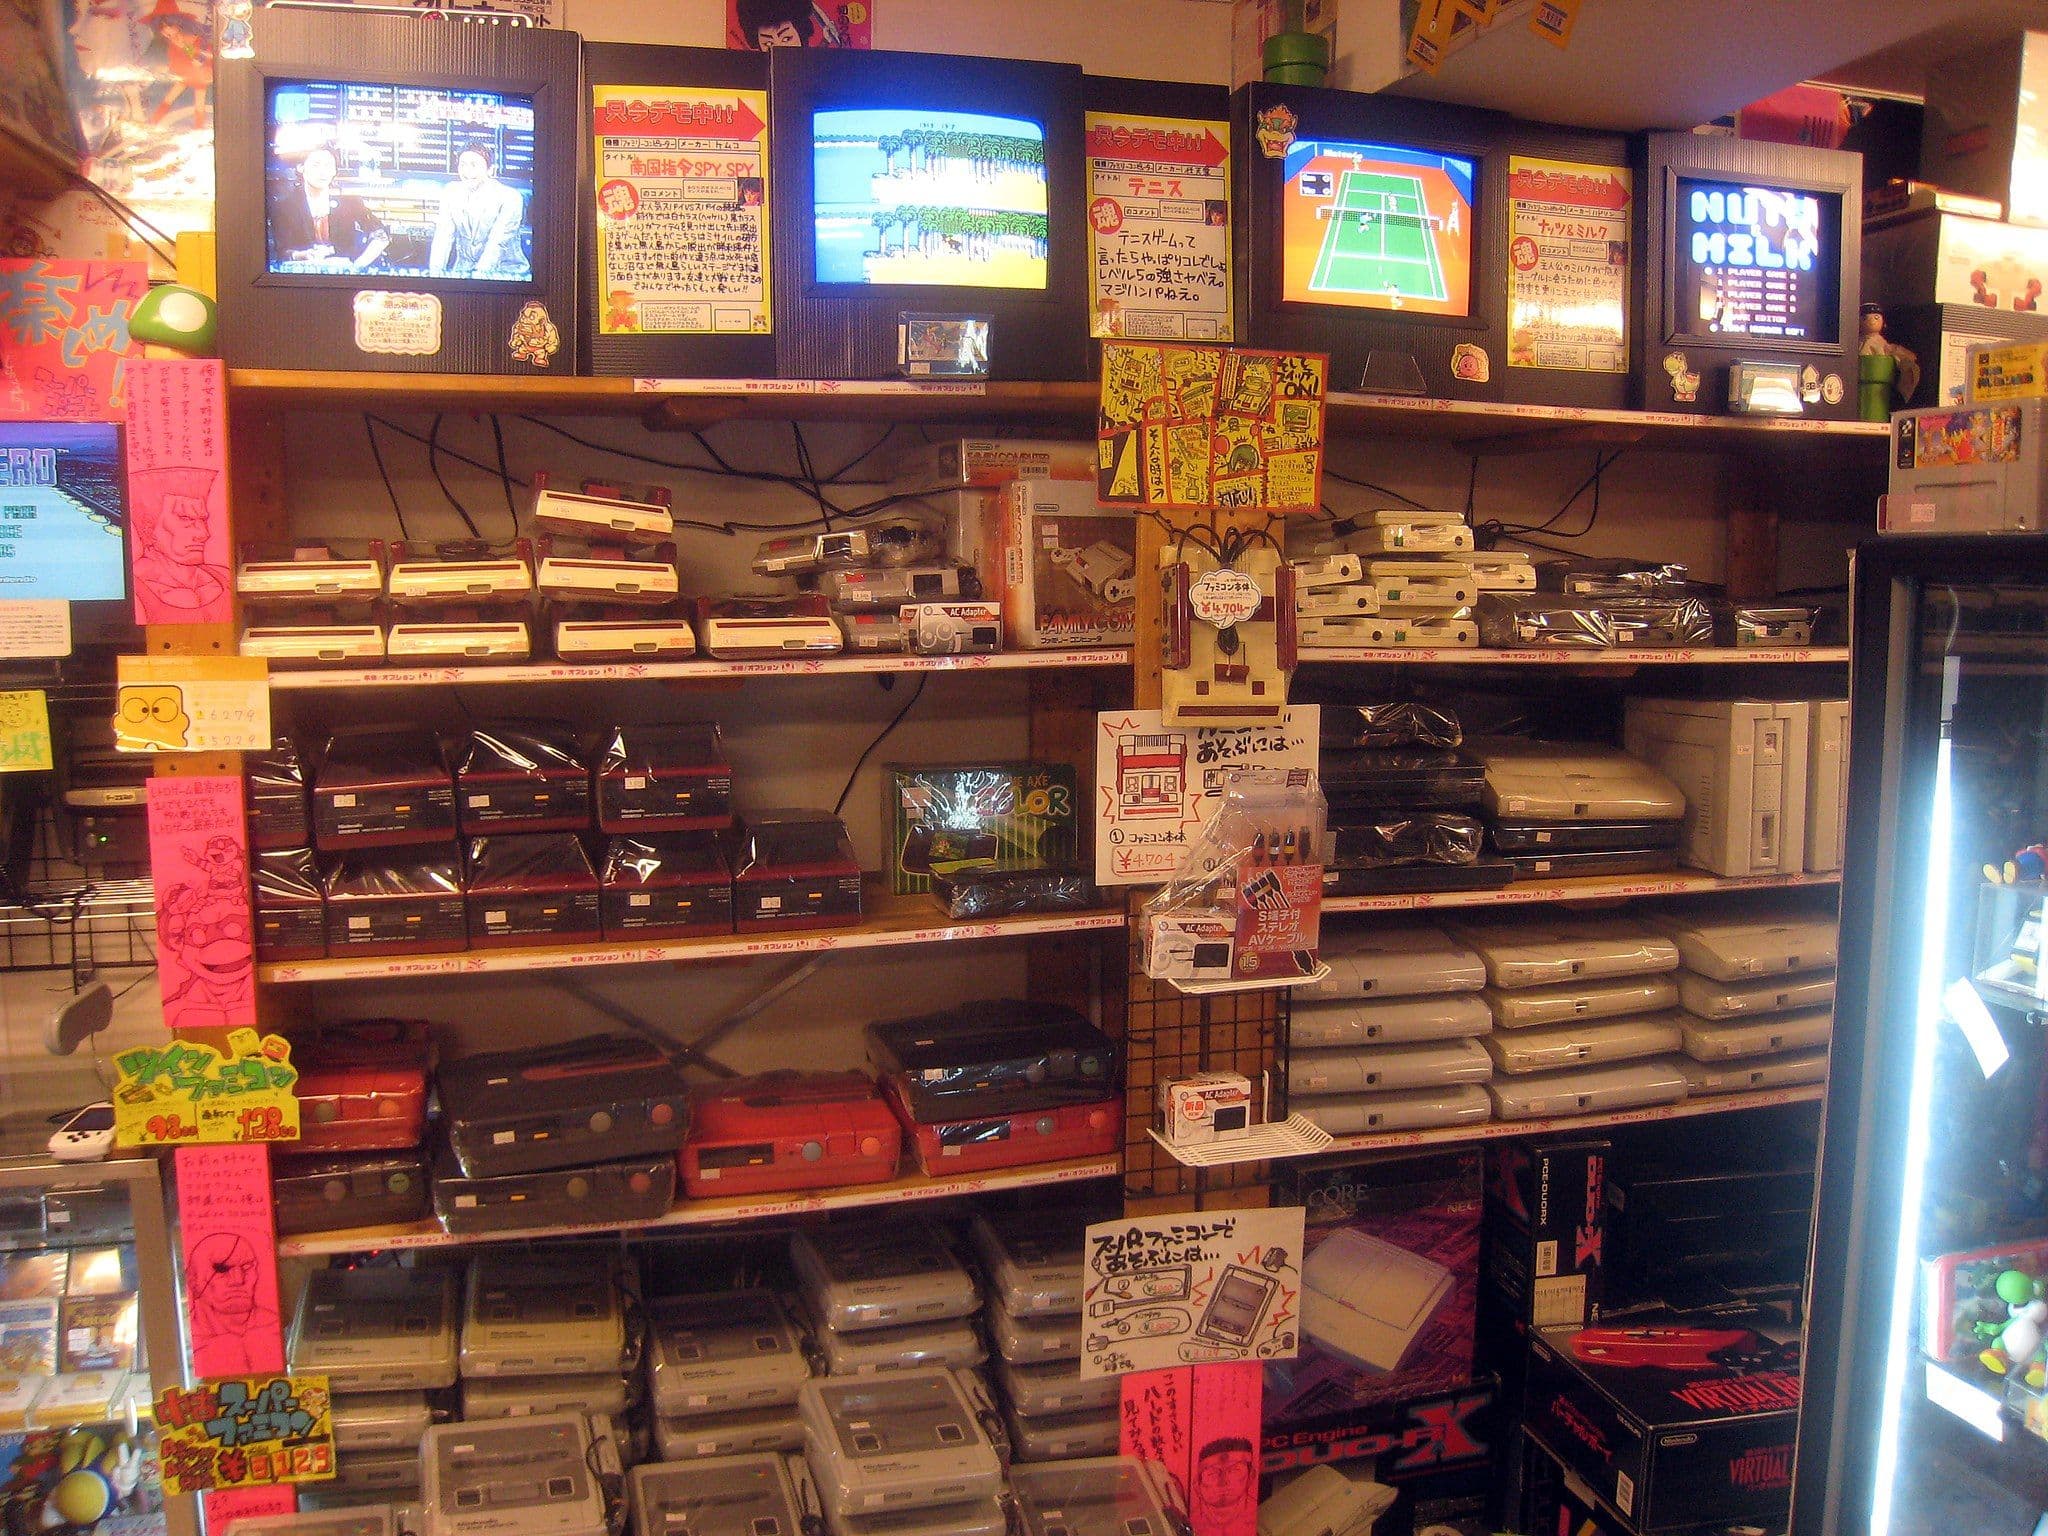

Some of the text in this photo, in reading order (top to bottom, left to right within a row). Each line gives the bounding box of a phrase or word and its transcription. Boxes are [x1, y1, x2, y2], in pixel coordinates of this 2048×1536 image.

[1128, 178, 1184, 197] テニス
[1118, 228, 1196, 249] テニスゲームって
[1203, 582, 1250, 592] ファミコン本体
[950, 607, 988, 617] AC Adapter
[1185, 924, 1223, 934] AC Adapter
[1293, 1423, 1369, 1444] Engine
